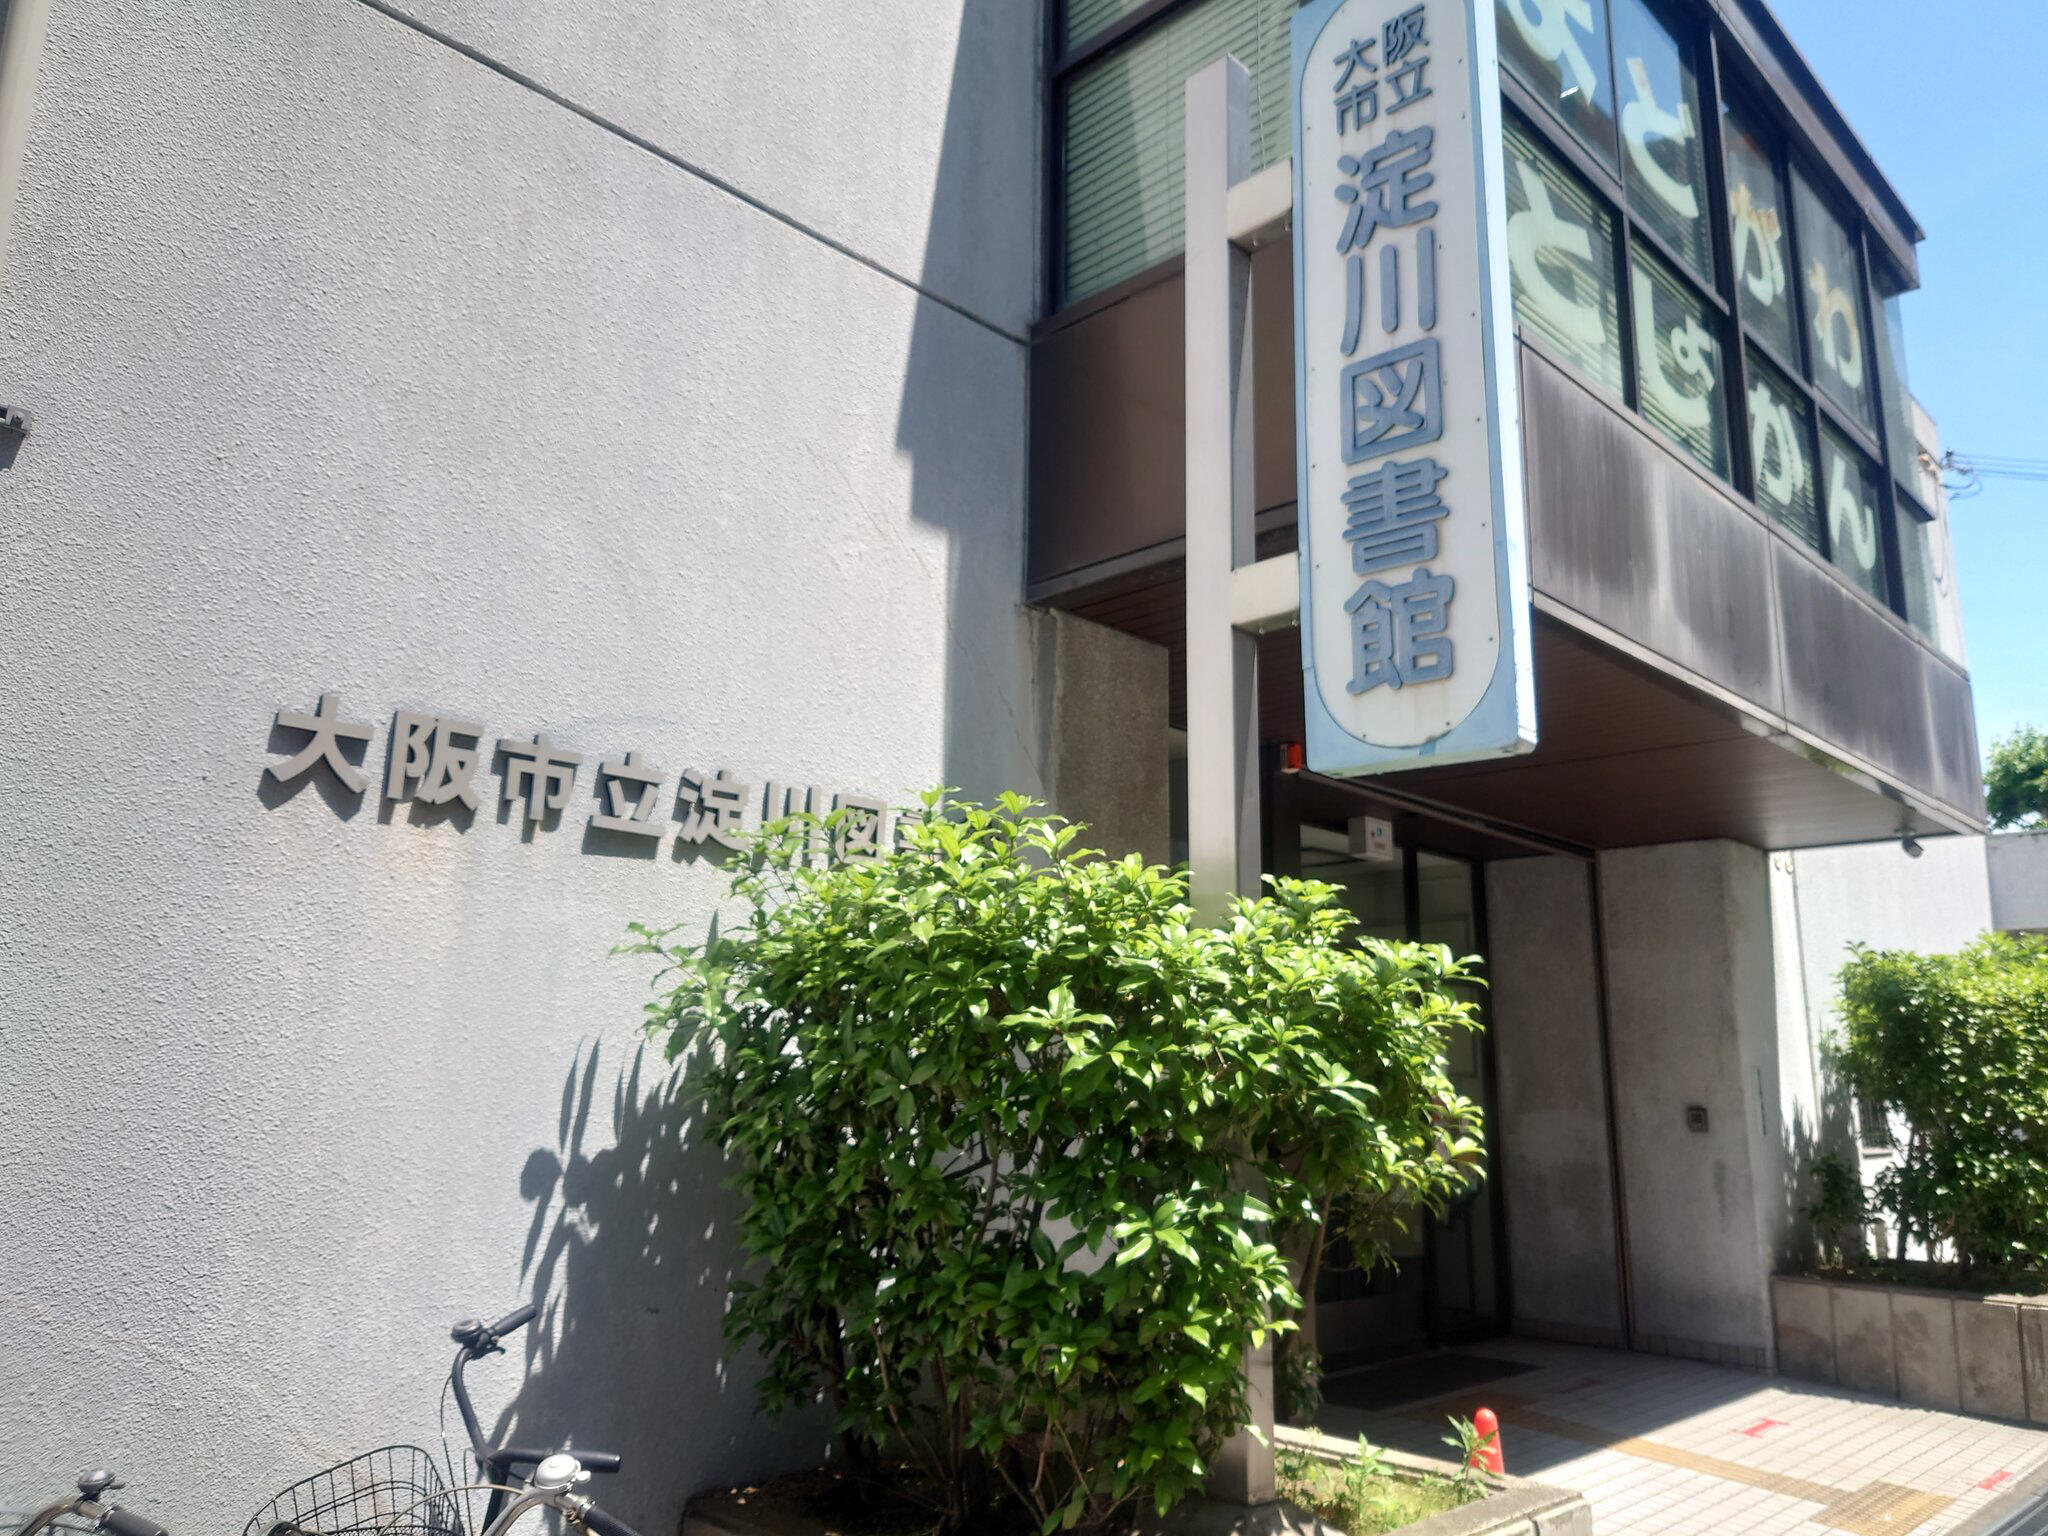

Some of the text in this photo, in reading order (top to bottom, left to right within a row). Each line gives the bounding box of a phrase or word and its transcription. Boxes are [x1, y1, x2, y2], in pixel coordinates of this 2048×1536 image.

[1334, 125, 1455, 696] 淀川図書館
[1507, 159, 1876, 570] としょかん
